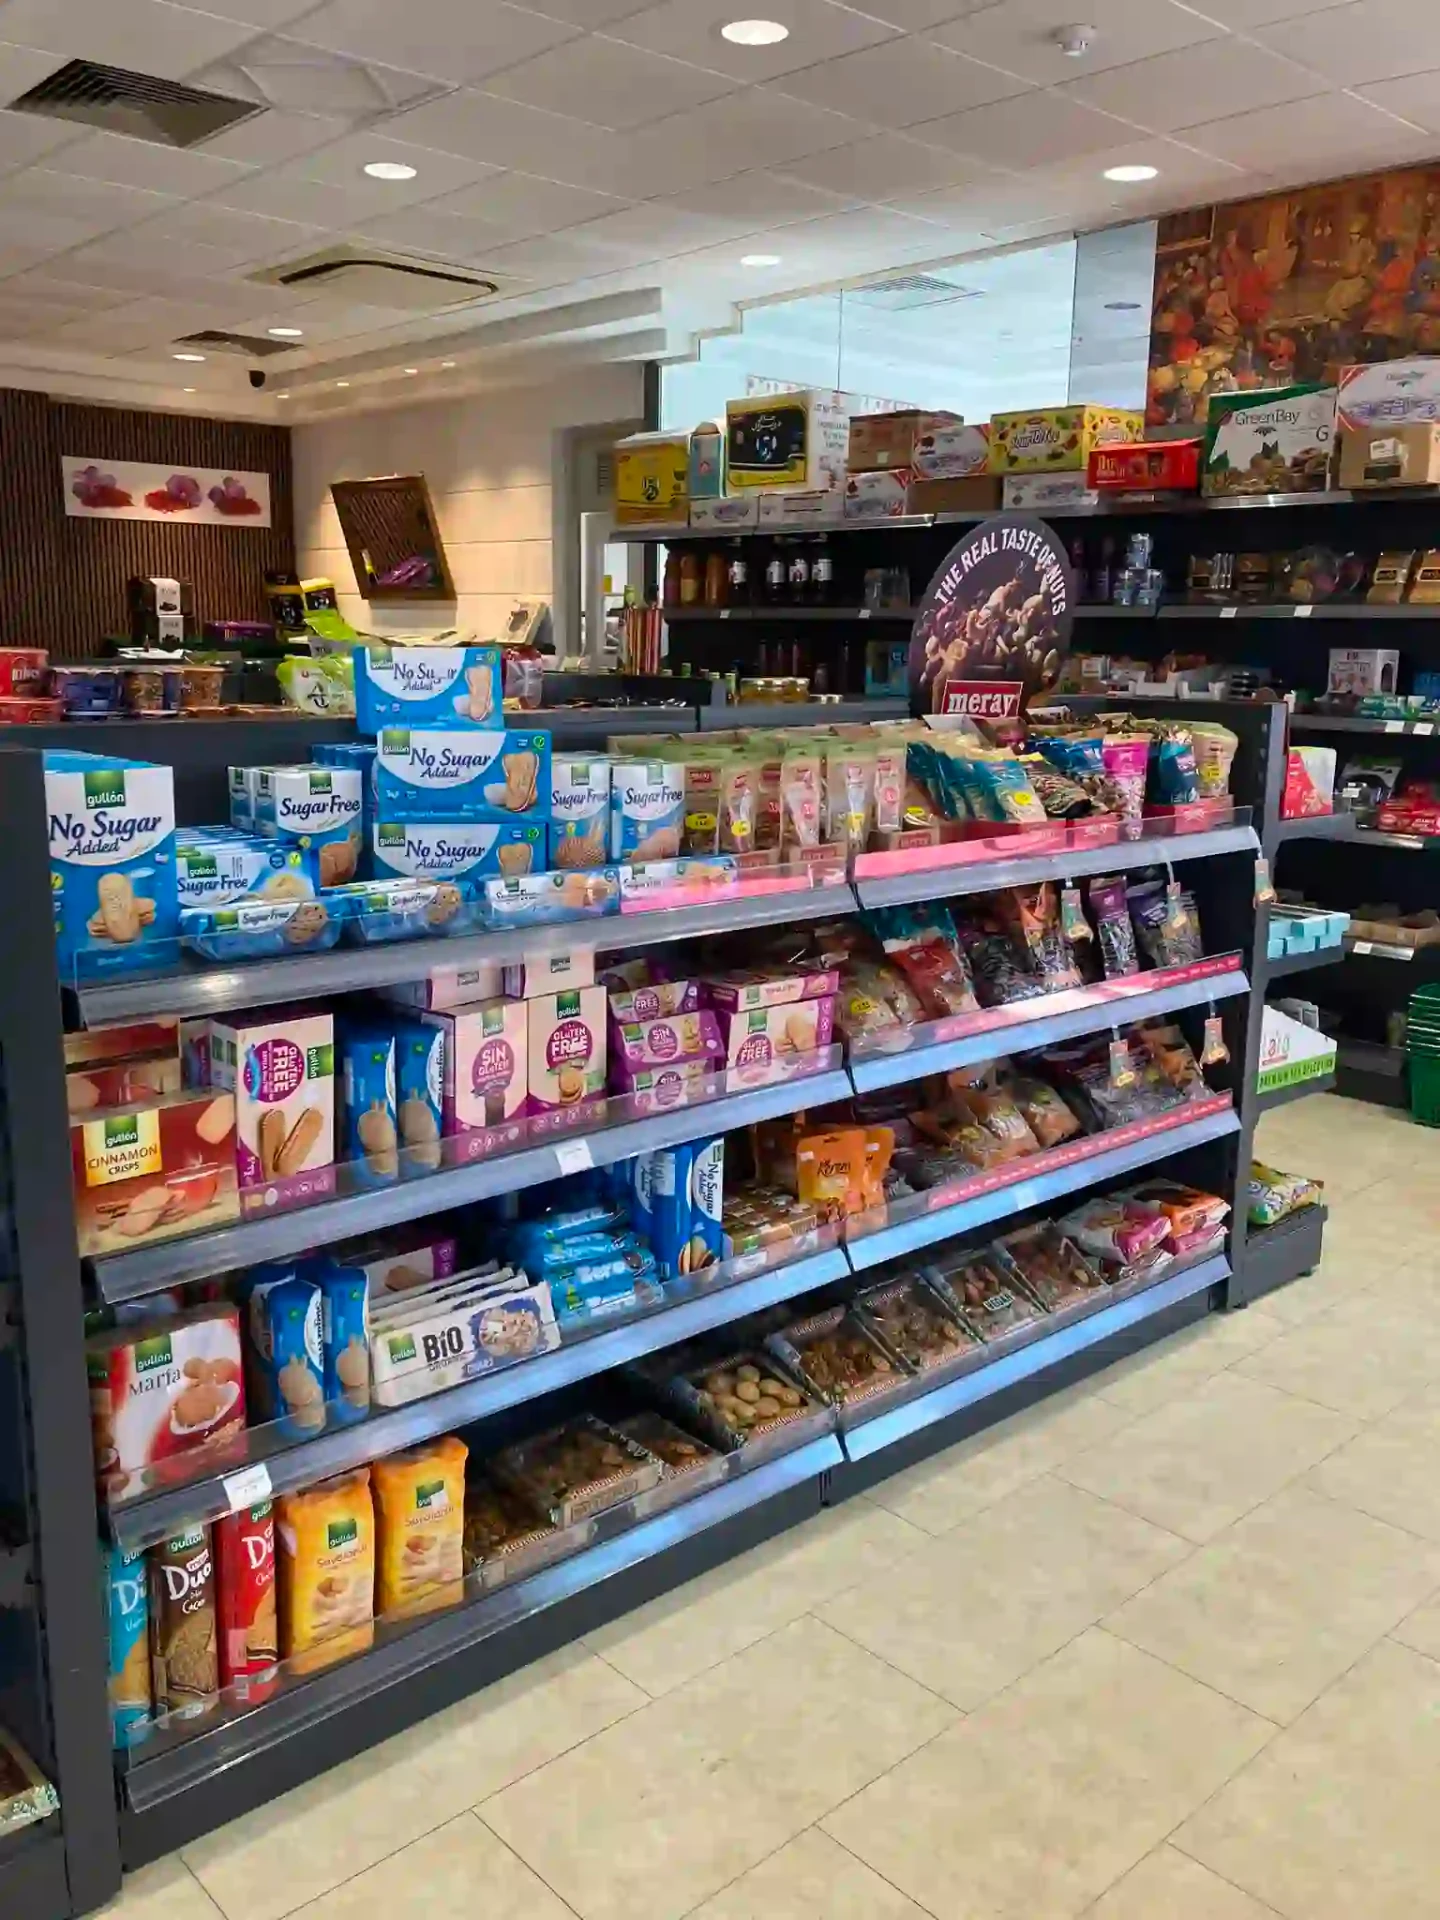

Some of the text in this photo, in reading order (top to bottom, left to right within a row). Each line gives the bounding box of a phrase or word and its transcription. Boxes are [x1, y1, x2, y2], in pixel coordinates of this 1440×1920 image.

[934, 564, 963, 604] THE
[960, 532, 999, 573] REAL
[1001, 527, 1042, 557] TASTE
[1045, 563, 1066, 616] NUTS
[393, 662, 414, 680] No
[947, 690, 1017, 717] meray
[409, 747, 492, 773] No Sugar
[420, 767, 459, 778] Added
[87, 791, 125, 807] gullón
[49, 810, 162, 842] No Sugar
[65, 838, 121, 857] Added
[404, 838, 486, 863] No Sugar
[415, 858, 454, 870] Added
[482, 1044, 507, 1067] SIN
[551, 1035, 588, 1057] FREE
[740, 1044, 769, 1062] FREE
[273, 1045, 291, 1093] FREE
[87, 1143, 158, 1169] CINNAMON
[108, 1161, 140, 1175] CRISPS
[706, 1161, 720, 1181] No
[161, 1561, 212, 1601] Duo
